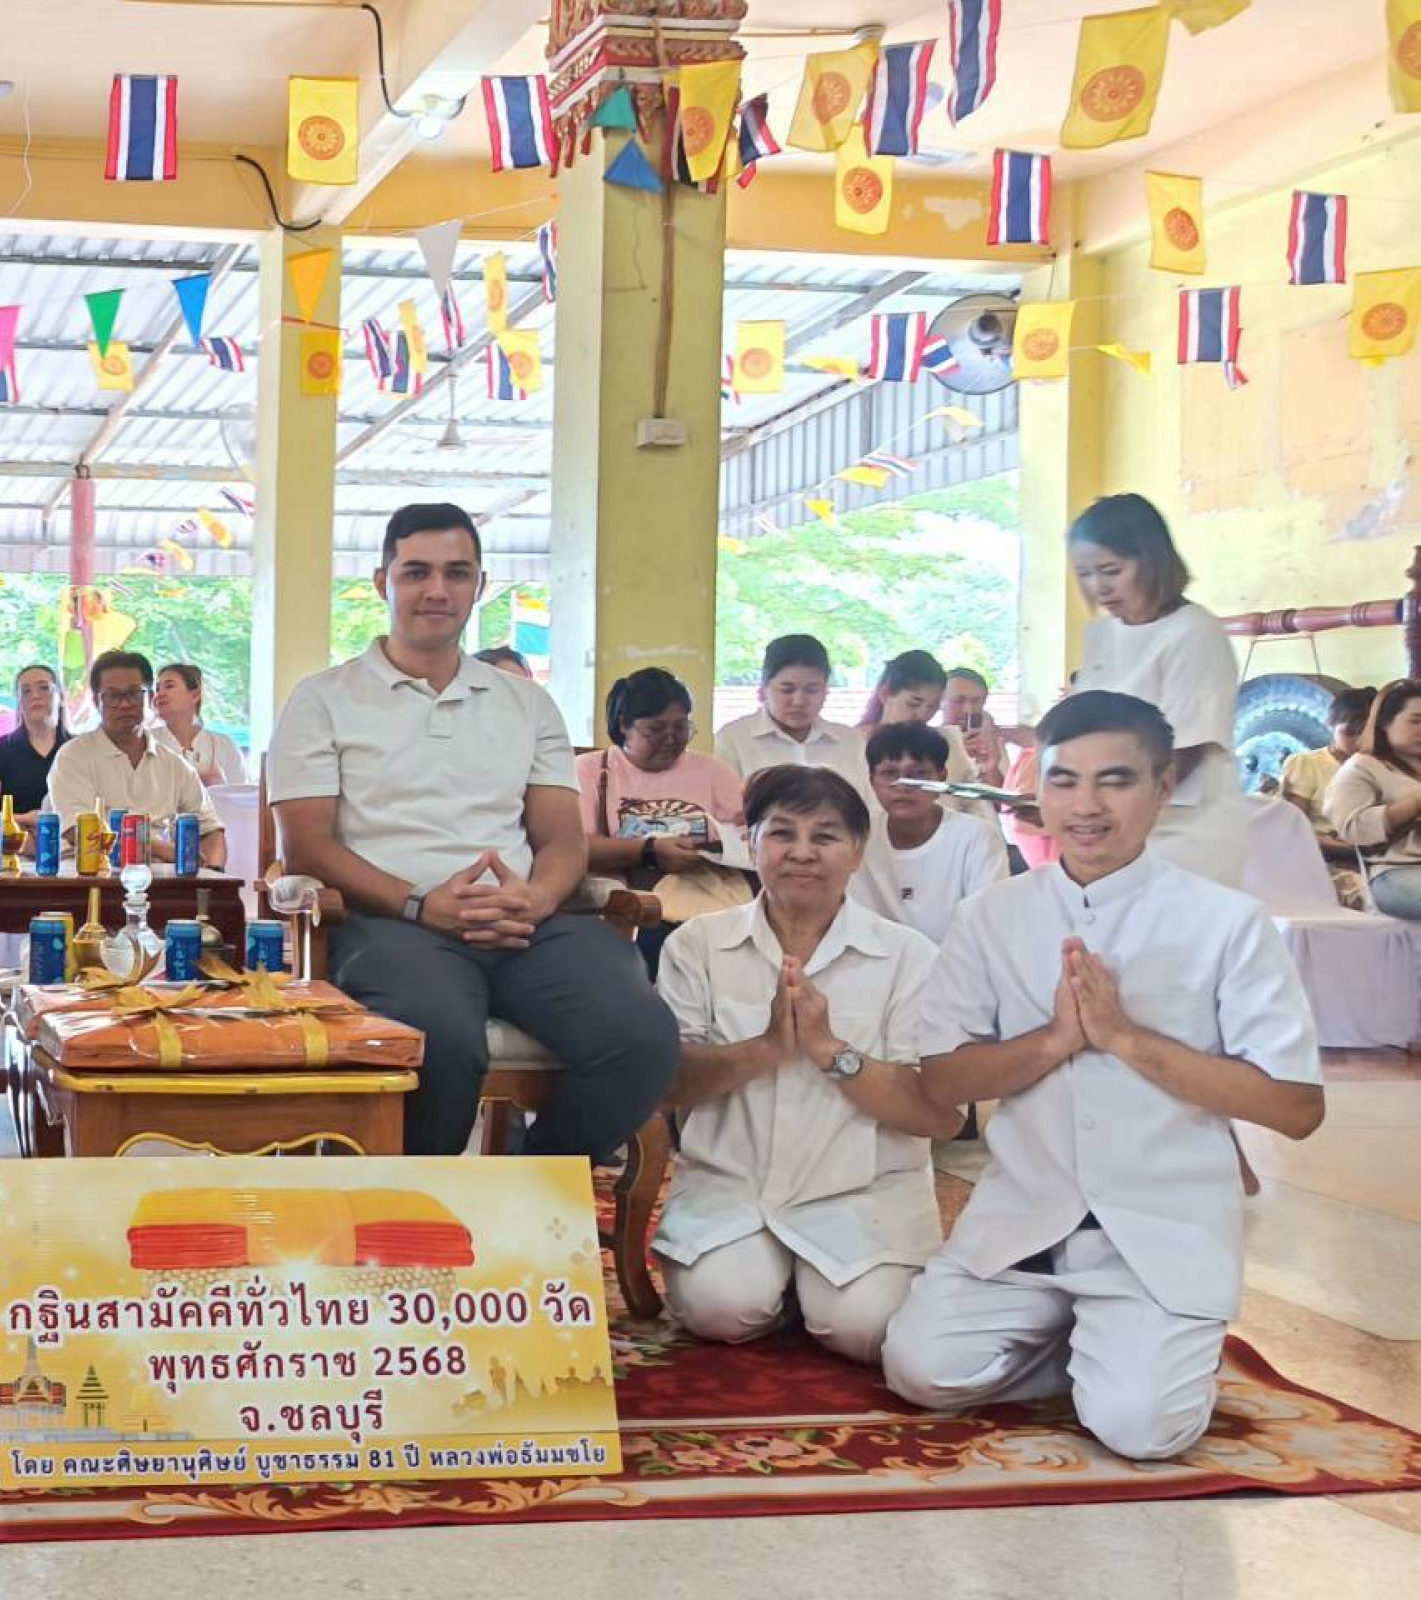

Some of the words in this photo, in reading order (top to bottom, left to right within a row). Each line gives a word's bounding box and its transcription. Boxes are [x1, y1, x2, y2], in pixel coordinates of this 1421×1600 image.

[9, 1275, 369, 1343] กฐินสามัคคีทั่วไทย
[389, 1292, 527, 1330] 30,000
[545, 1282, 591, 1323] วัด
[149, 1340, 356, 1393] พุทธศักราช
[374, 1346, 466, 1376] 2568
[240, 1389, 383, 1443] จ.ชลบุรี
[11, 1449, 53, 1475] โดย
[64, 1446, 246, 1479] คณะศิษยานุศิษย์
[257, 1452, 358, 1478] บูชาธรรม
[369, 1450, 394, 1468] 81
[405, 1444, 419, 1466] ปี
[429, 1438, 605, 1466] หลวงพ่อธัมมชโย
